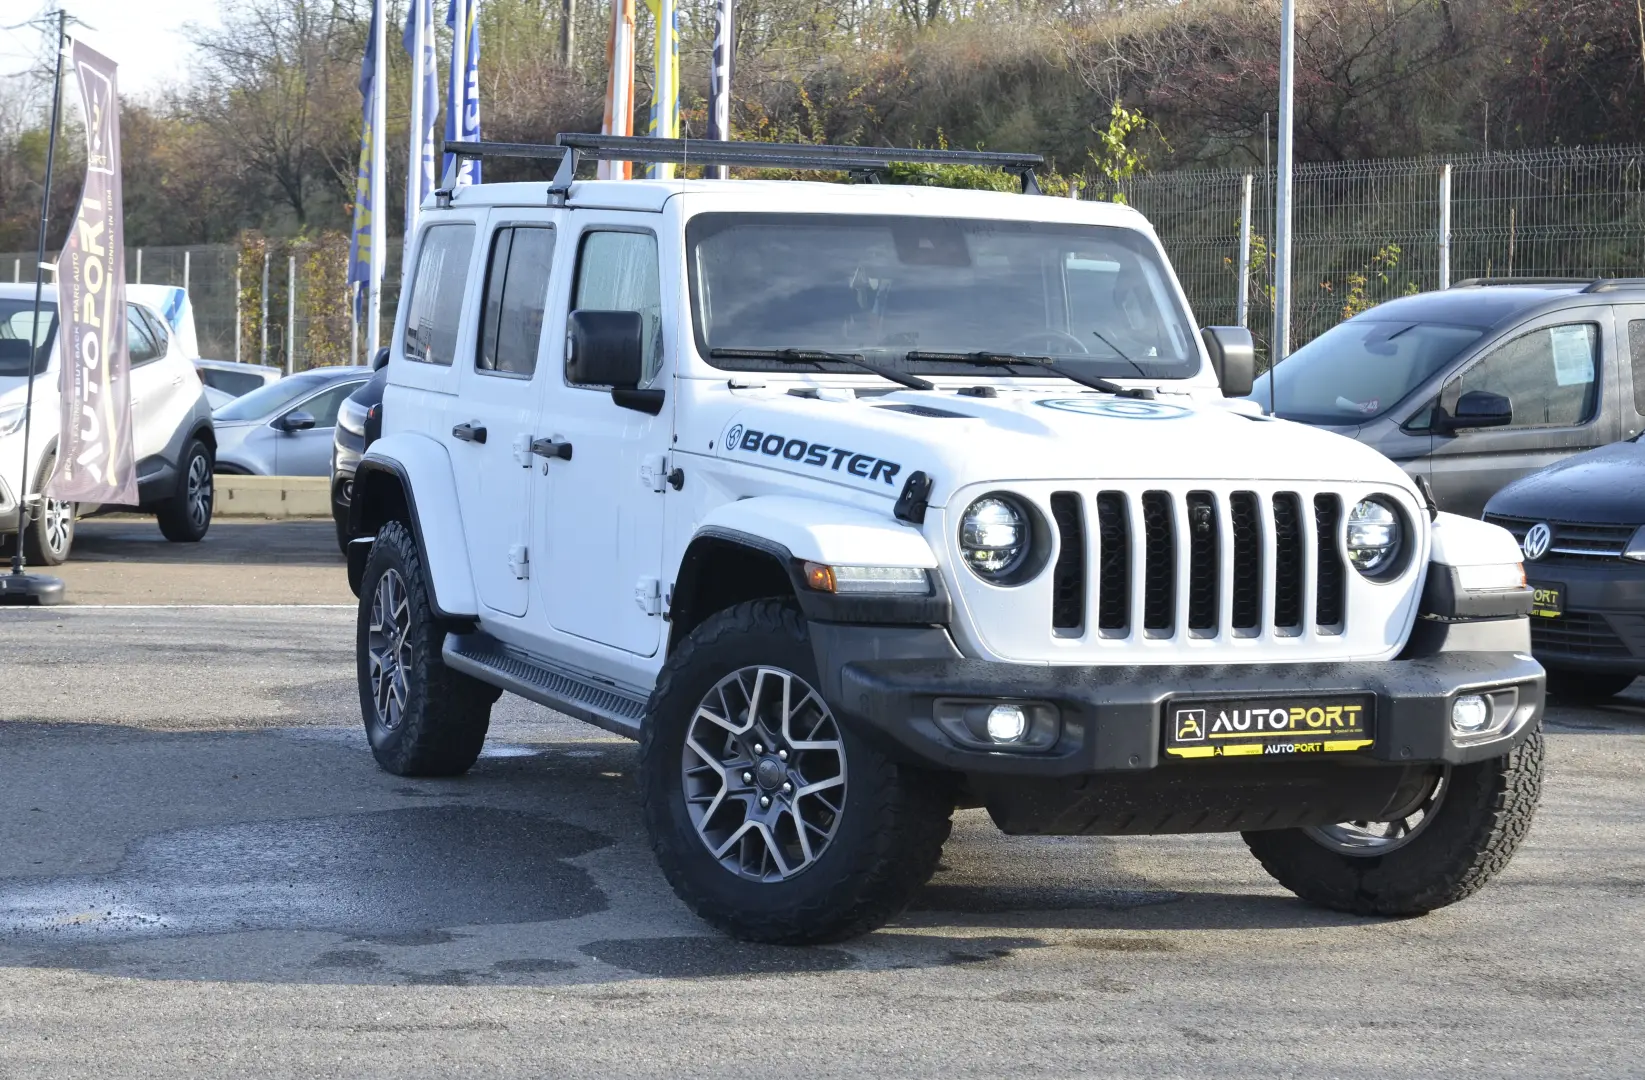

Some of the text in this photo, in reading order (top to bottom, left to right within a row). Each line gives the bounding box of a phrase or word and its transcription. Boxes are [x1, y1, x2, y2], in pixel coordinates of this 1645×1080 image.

[107, 215, 113, 226] IN
[72, 253, 80, 281] AUTO
[77, 197, 104, 483] AUTOPORT
[740, 429, 901, 485] BOOSTER
[1211, 706, 1362, 731] AUTOPORT
[1265, 743, 1322, 754] AUTOPORT
